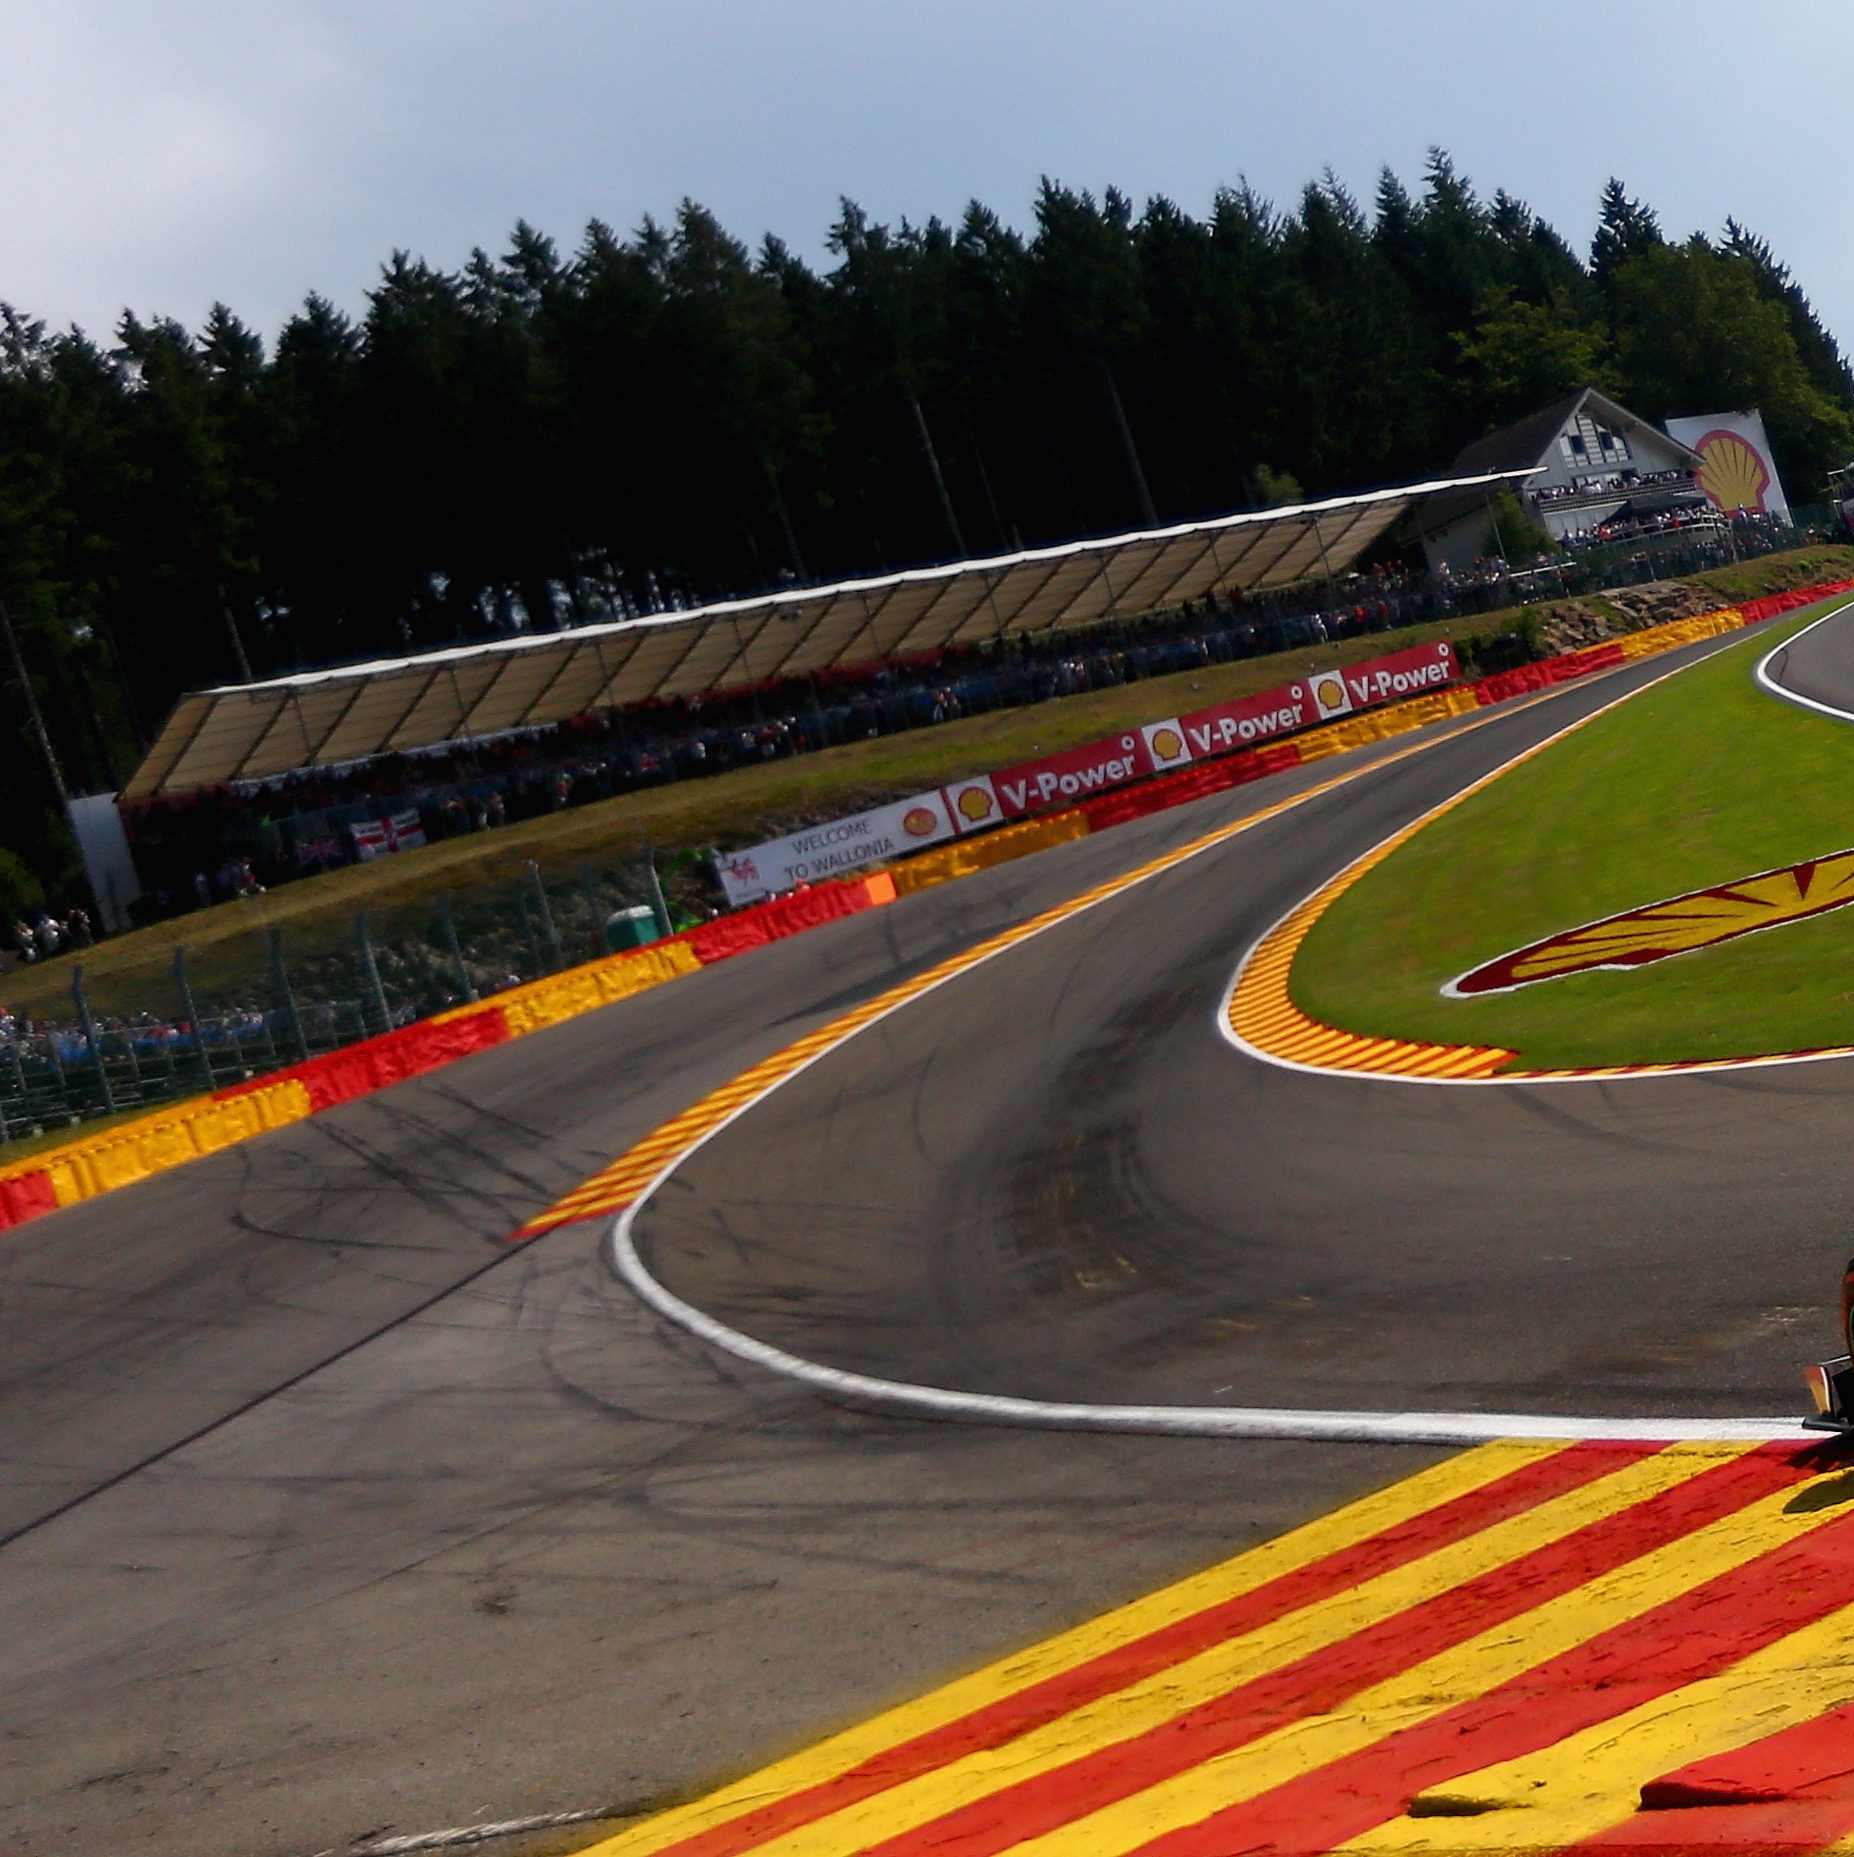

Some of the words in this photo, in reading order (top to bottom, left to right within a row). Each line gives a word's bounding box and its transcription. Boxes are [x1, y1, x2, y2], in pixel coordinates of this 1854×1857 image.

[1349, 660, 1449, 702] V-Power
[1190, 702, 1304, 751] V-Power
[1002, 753, 1135, 809] V-Power
[784, 863, 809, 880] TO
[812, 837, 894, 872] WALLONIA
[792, 820, 872, 855] WELCOME
